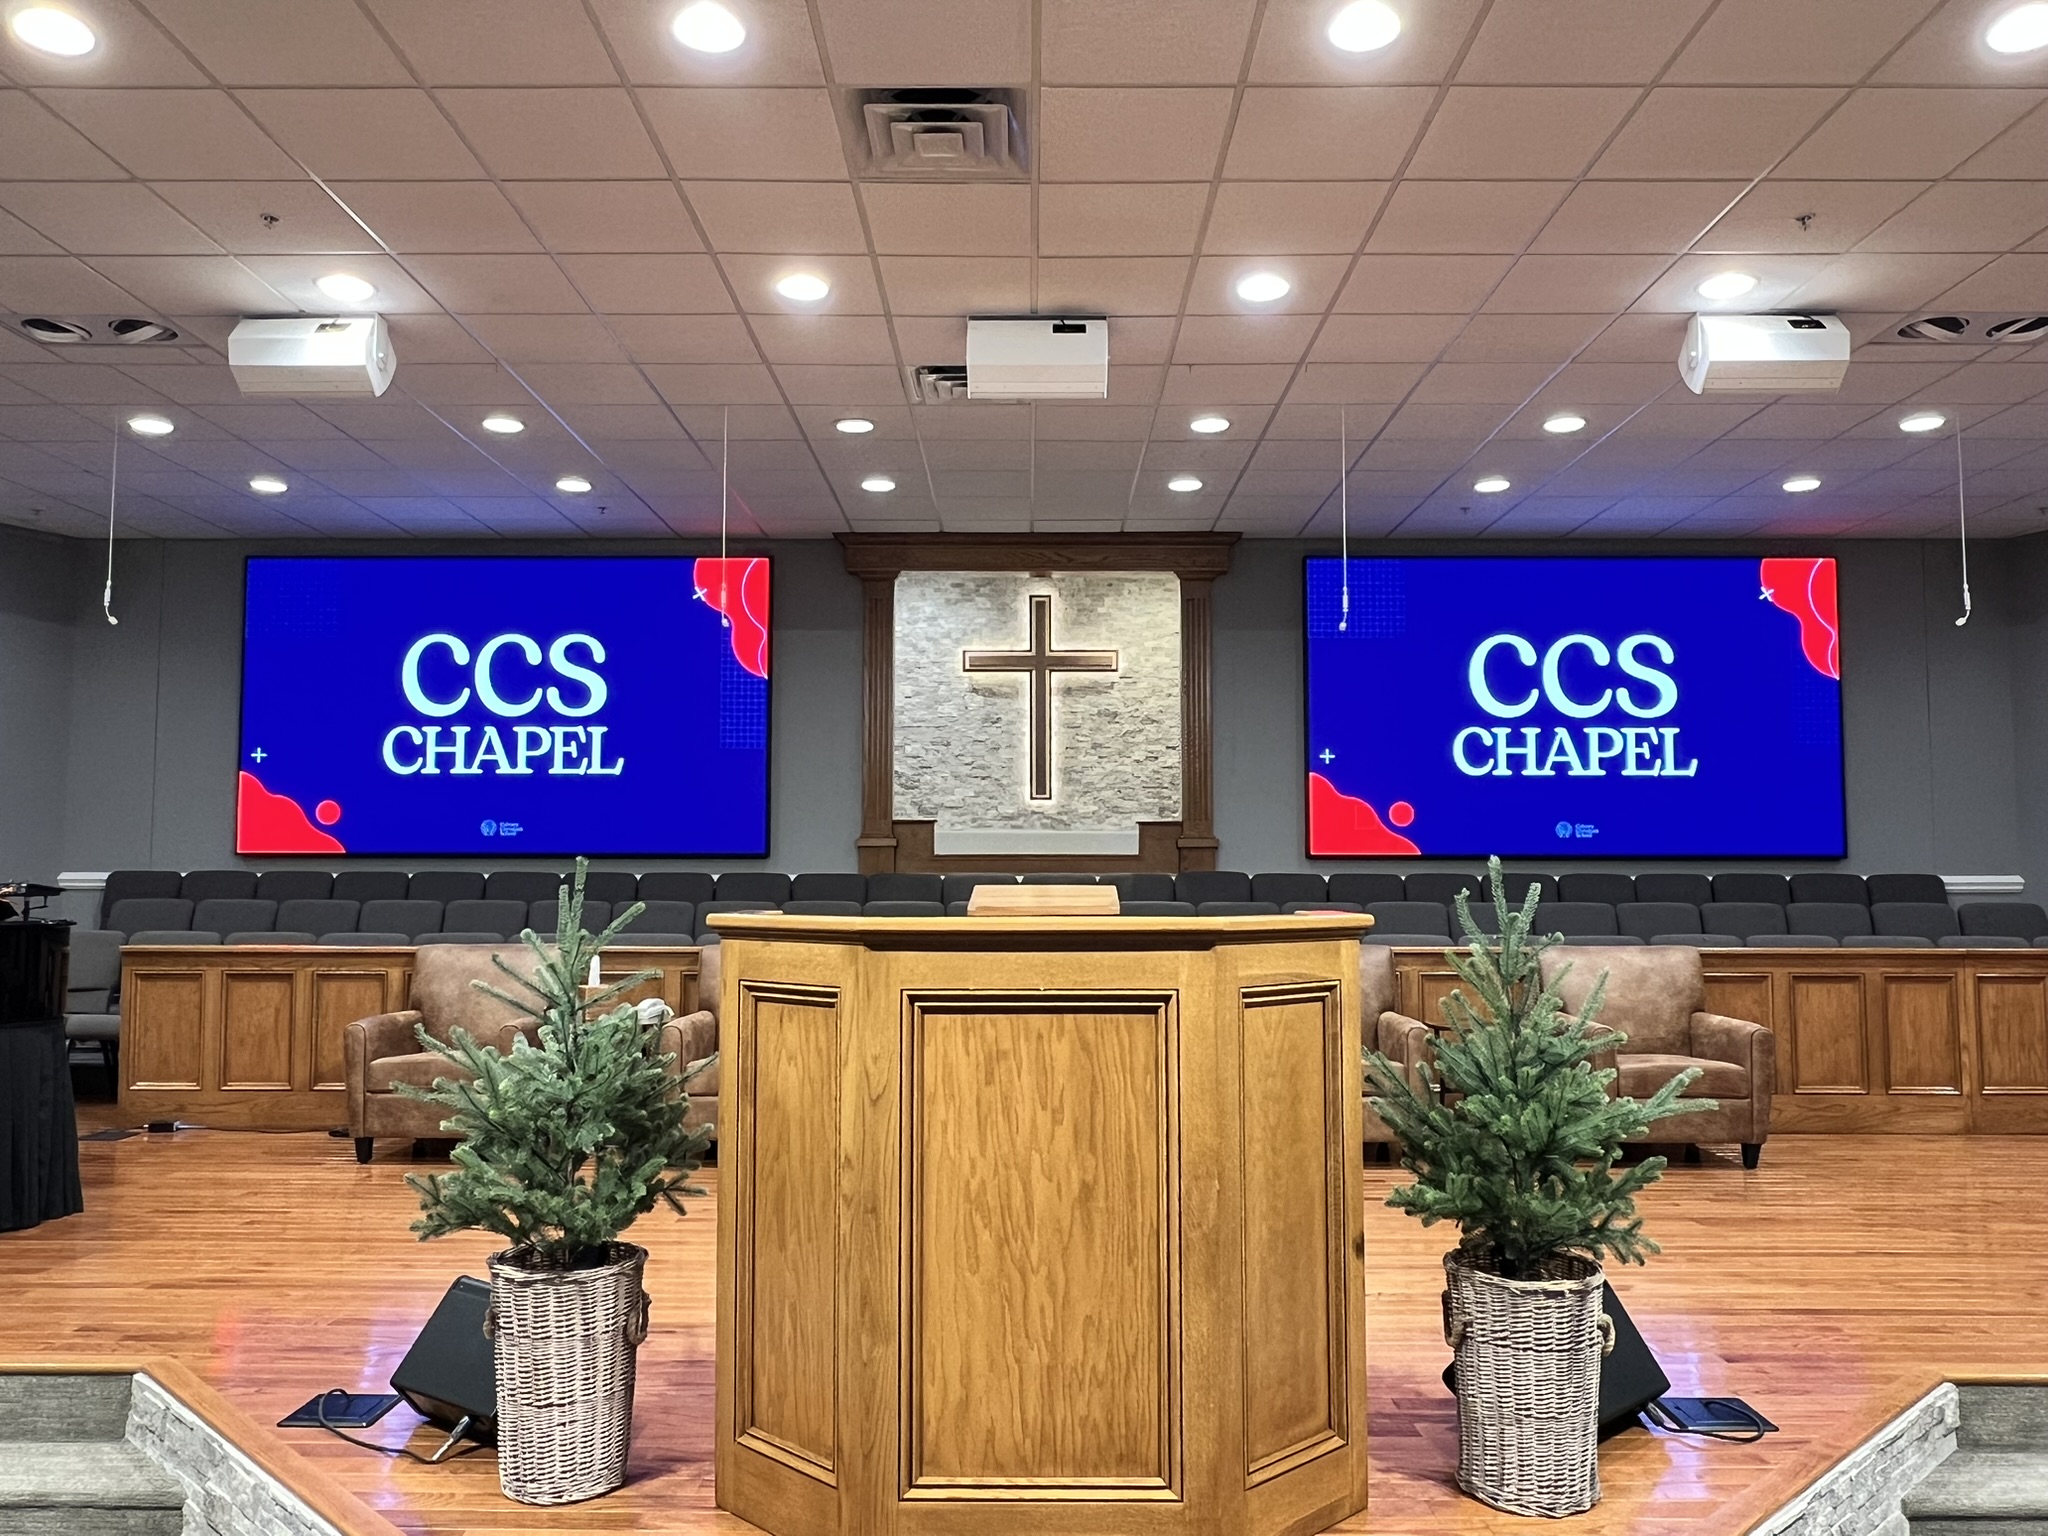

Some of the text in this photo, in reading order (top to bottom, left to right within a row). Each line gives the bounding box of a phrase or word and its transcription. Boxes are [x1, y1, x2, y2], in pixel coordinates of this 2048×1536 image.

[401, 633, 608, 718] CCS
[1468, 633, 1678, 719] CCS
[382, 724, 625, 776] CHAPEL
[1452, 726, 1699, 777] CHAPEL
